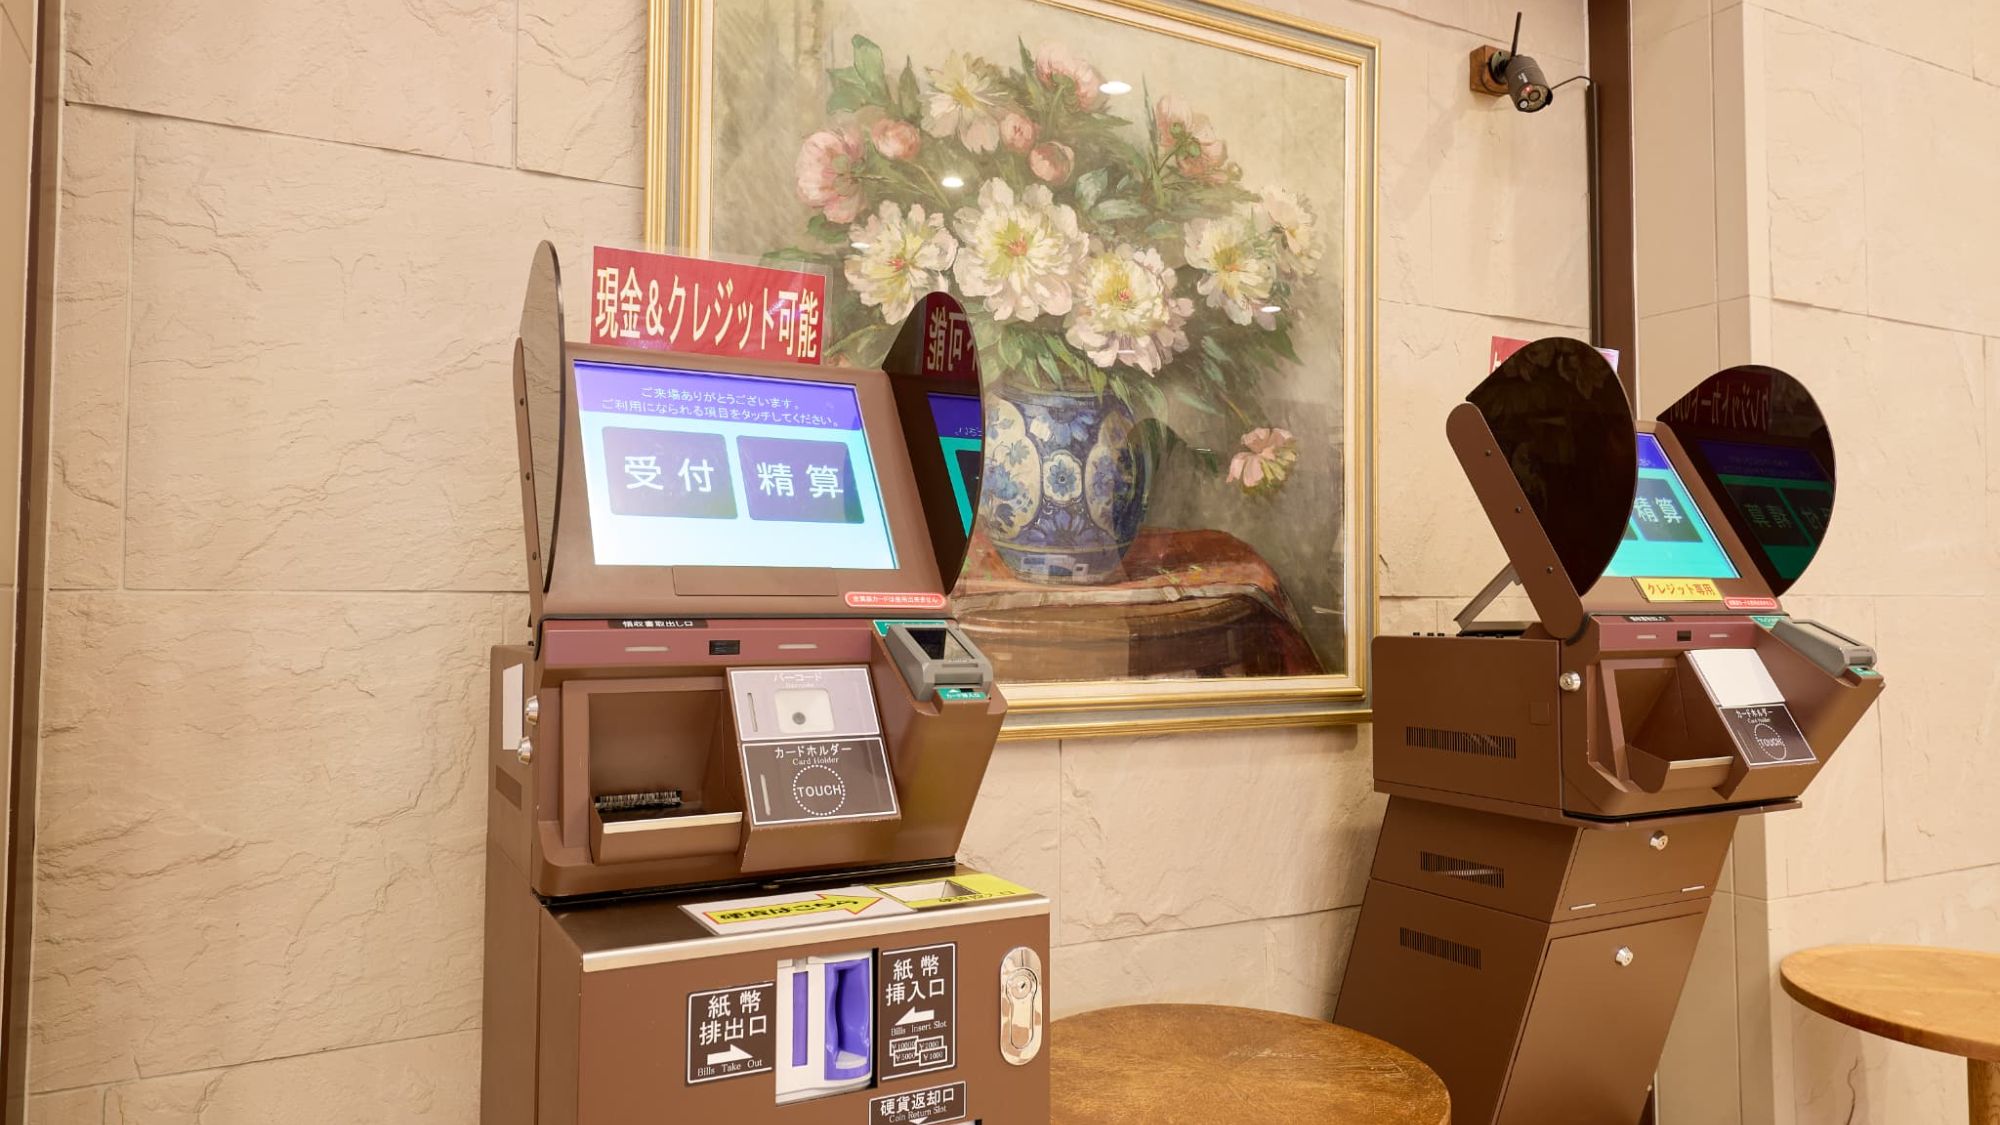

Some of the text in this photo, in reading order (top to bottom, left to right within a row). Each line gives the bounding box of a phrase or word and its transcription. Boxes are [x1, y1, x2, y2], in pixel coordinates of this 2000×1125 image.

[594, 266, 819, 359] 現金&クレジット可能
[640, 386, 799, 411] ご来場ありがとうございます。
[601, 399, 839, 428] ご利用になられる項目をタッチしてください。
[624, 456, 714, 493] 受付
[756, 462, 844, 499] 精算
[1647, 583, 1716, 596] クレジット専用
[774, 743, 852, 759] カードホルダー
[792, 756, 840, 766] Card Holder
[796, 784, 842, 798] TOUCH
[893, 954, 940, 981] 紙幣
[708, 989, 762, 1019] 紙幣
[885, 978, 945, 1007] 挿入口
[699, 1015, 767, 1046] 排出口
[911, 1022, 933, 1033] Insert
[933, 1020, 947, 1030] Slot
[697, 1059, 763, 1077] Bills Take Out
[880, 1087, 955, 1116] 硬貨返却口
[889, 1105, 947, 1123] Coin Return Slot
